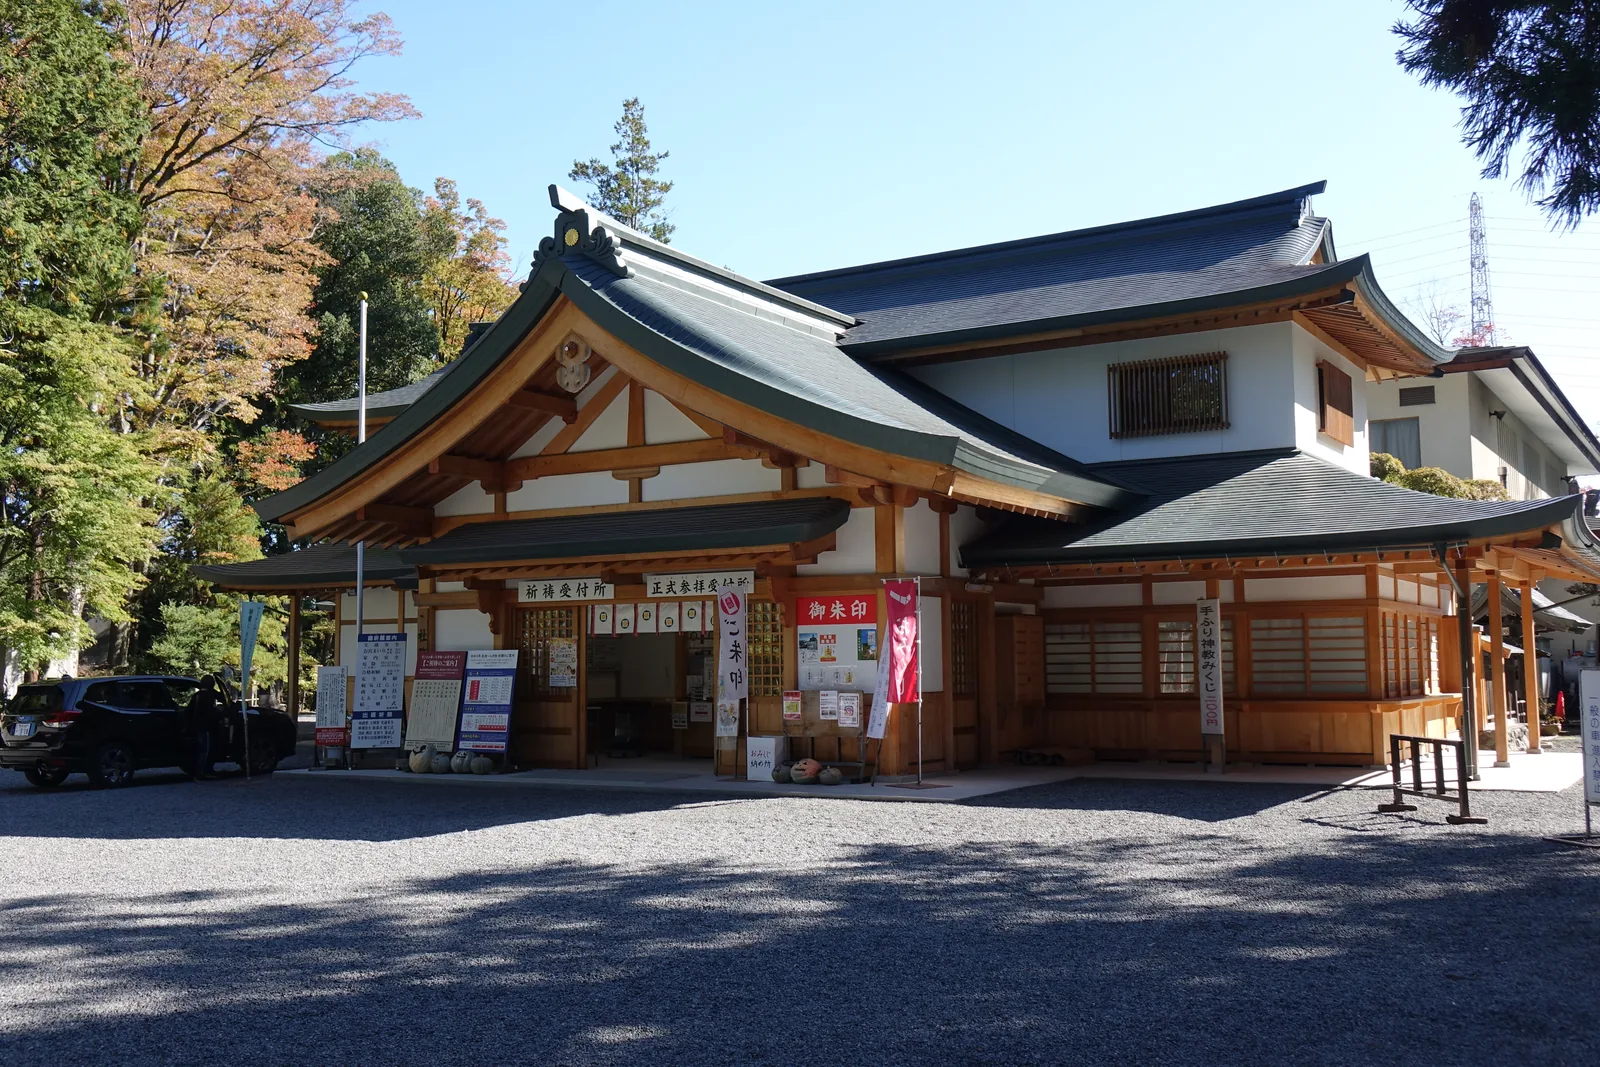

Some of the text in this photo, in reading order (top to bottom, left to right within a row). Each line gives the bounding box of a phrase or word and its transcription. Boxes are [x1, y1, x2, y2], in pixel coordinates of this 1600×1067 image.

[808, 600, 868, 620] 御朱印
[1200, 606, 1216, 692] 手ふり神教みくじ
[751, 750, 771, 759] おみくじ
[751, 760, 771, 768] 納め所
